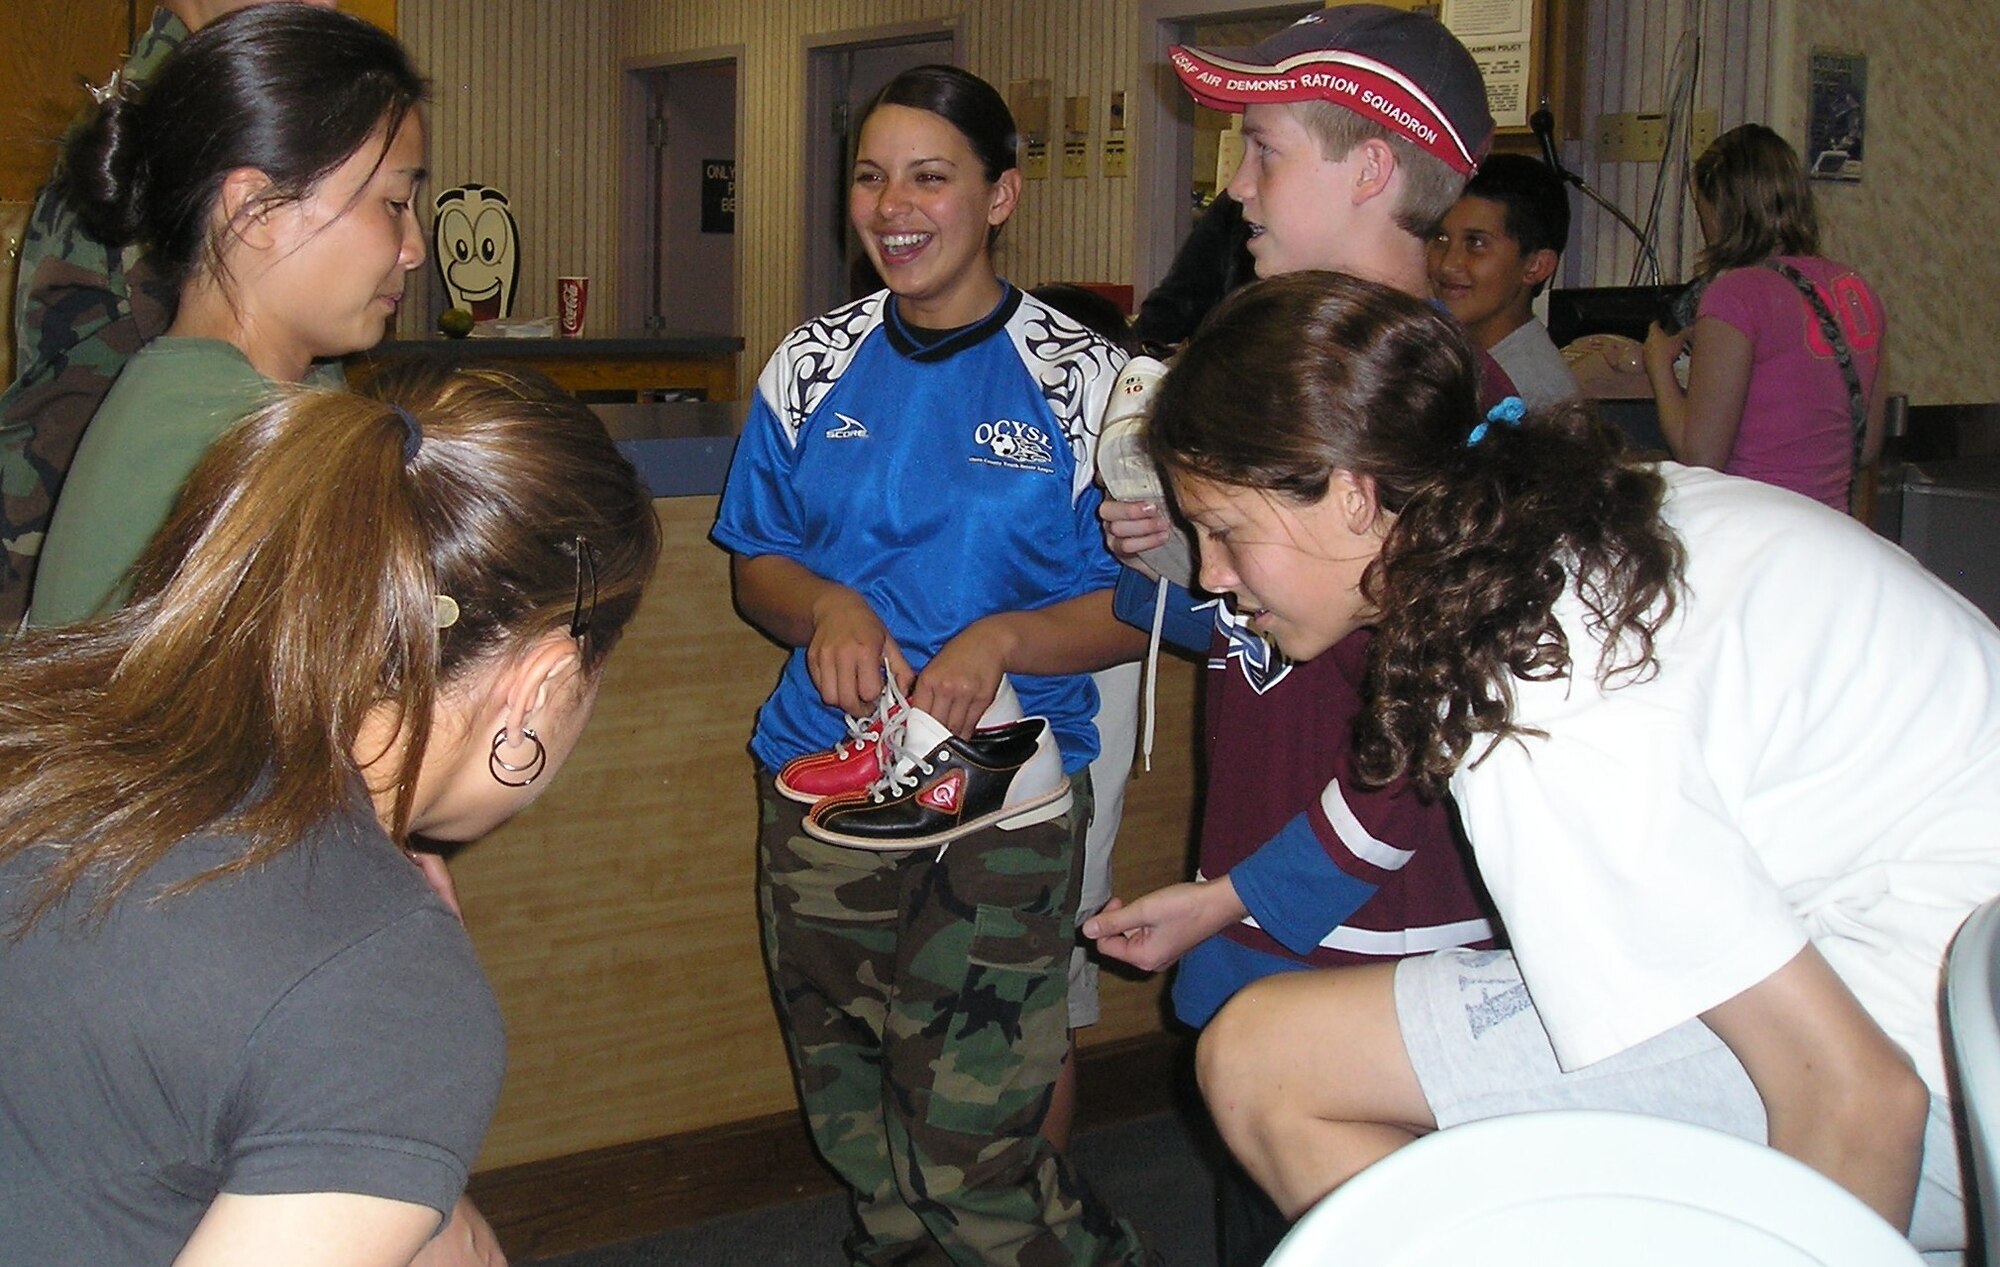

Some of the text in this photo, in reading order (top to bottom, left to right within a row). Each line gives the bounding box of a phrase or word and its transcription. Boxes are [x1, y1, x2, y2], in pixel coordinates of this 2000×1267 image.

[1172, 52, 1199, 74] USAF
[1196, 72, 1222, 87] AIR
[1300, 73, 1359, 96] RATION
[1361, 90, 1438, 144] SQUADRON
[826, 430, 869, 438] SCORE
[975, 420, 1053, 449] OCYSL
